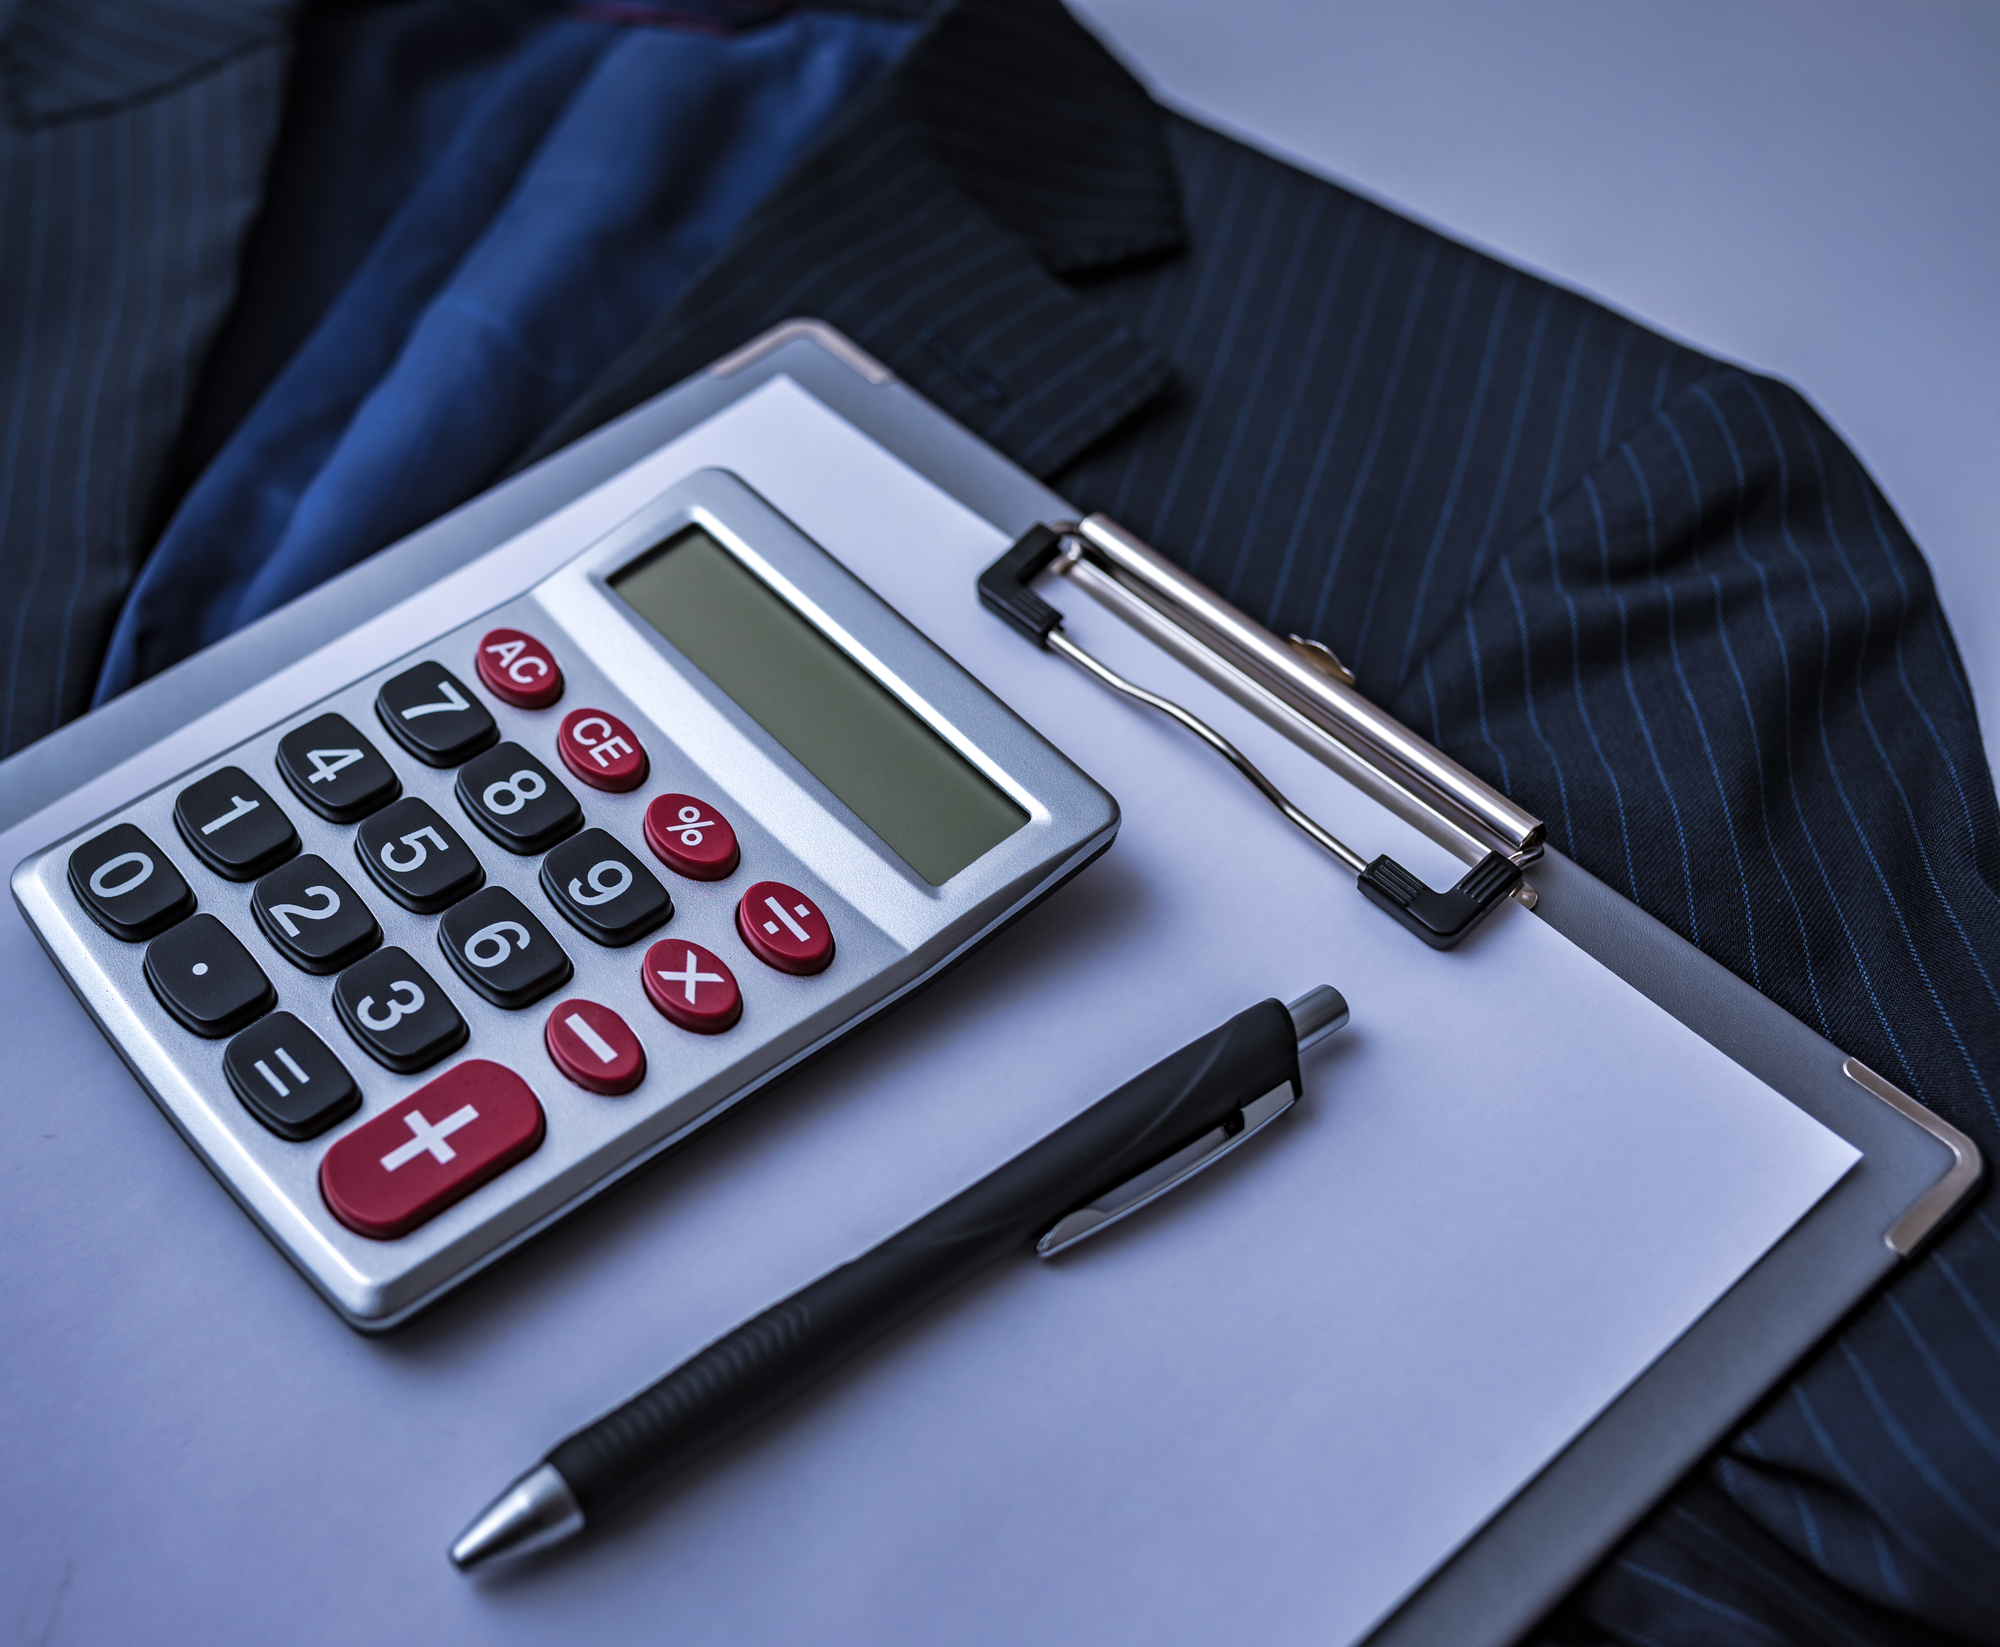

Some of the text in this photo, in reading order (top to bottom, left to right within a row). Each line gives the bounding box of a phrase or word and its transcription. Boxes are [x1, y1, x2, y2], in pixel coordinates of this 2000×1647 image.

[487, 638, 547, 684] AC
[402, 681, 470, 720] 7
[573, 716, 633, 767] CE
[307, 749, 364, 783] 4
[483, 769, 547, 815] 8
[201, 796, 259, 835] 1
[666, 805, 715, 846] %
[381, 825, 450, 872] 5
[90, 853, 153, 897] 0
[568, 859, 633, 906] 9
[269, 886, 340, 937] 2
[465, 921, 530, 967] 6
[357, 981, 424, 1030] 3
[255, 1048, 309, 1096] =
[379, 1103, 479, 1171] +
